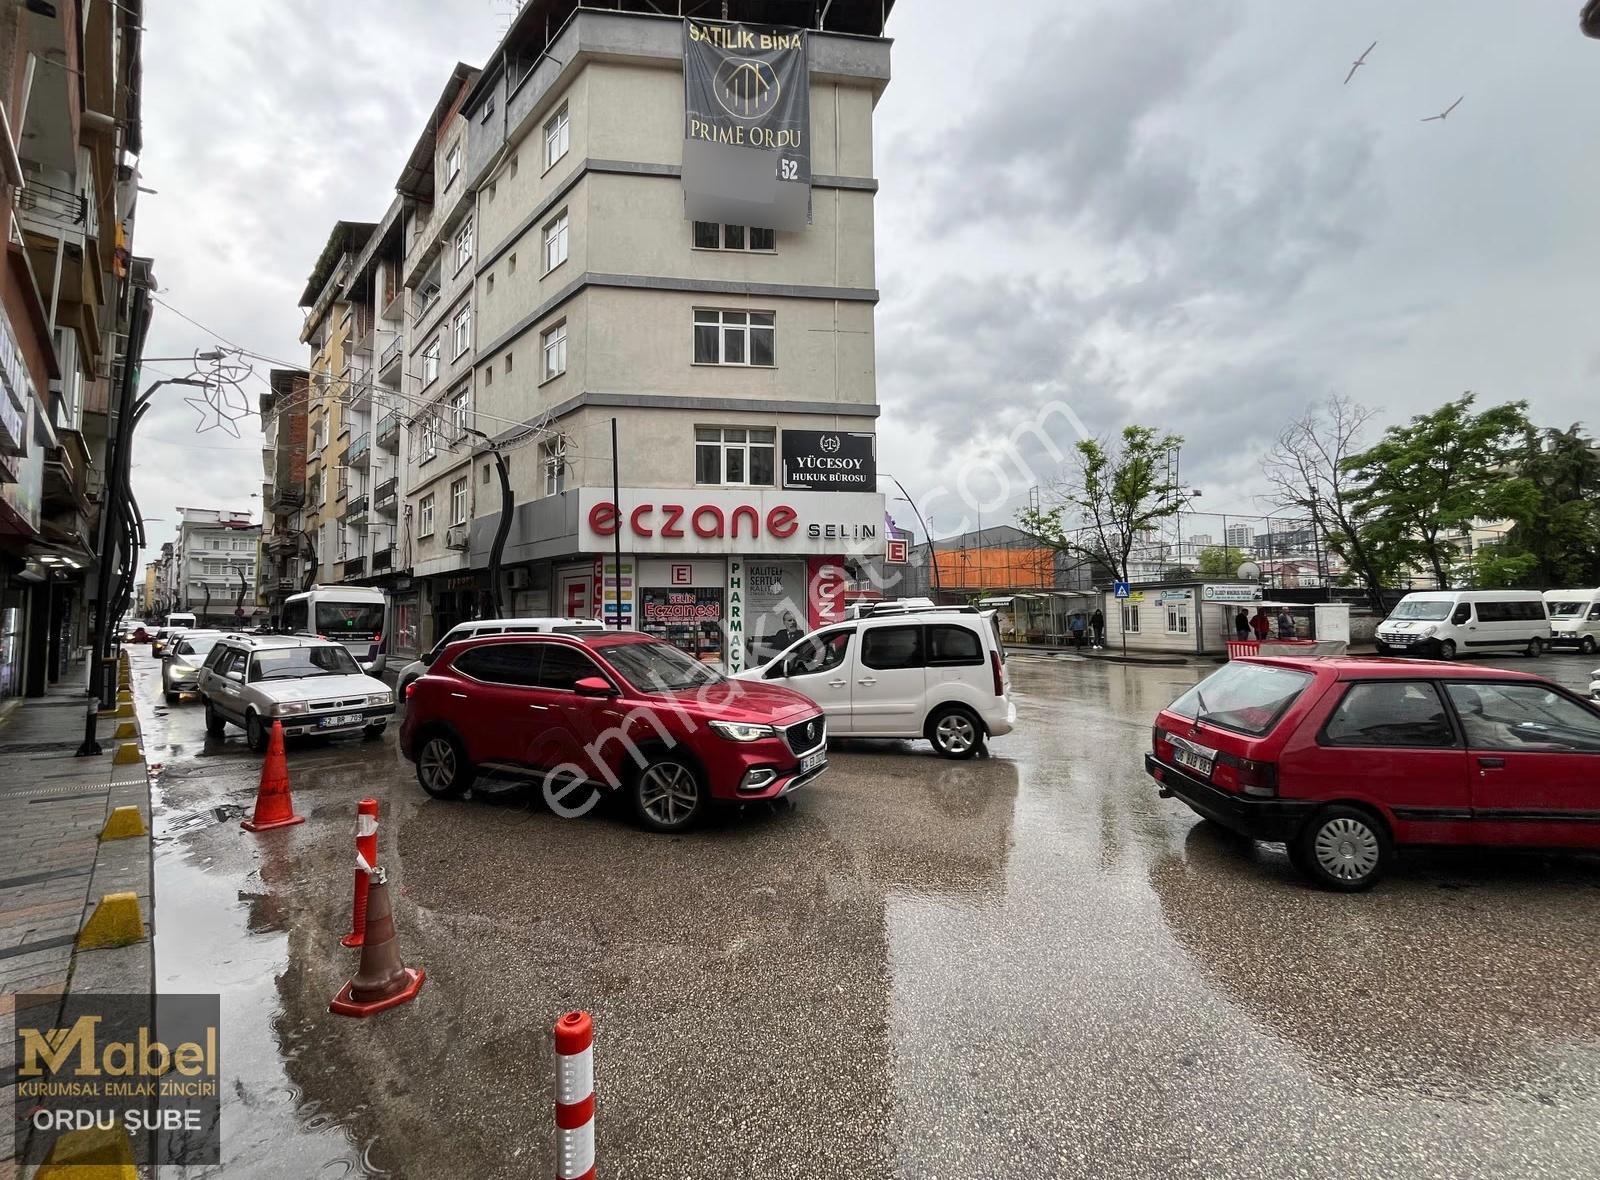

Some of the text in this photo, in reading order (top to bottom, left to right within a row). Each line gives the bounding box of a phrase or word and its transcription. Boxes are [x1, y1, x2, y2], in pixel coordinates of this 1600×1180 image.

[689, 24, 802, 50] SATILIK BİNA
[690, 119, 801, 148] PRIME ORDU
[781, 159, 798, 180] 52
[796, 455, 863, 470] YÜCESOY
[792, 472, 867, 483] HUKUK BÜROSU
[588, 502, 799, 539] eczane
[891, 544, 903, 559] E
[676, 568, 687, 581] E
[645, 602, 720, 617] Eczanesi
[730, 563, 742, 673] PHARMACY
